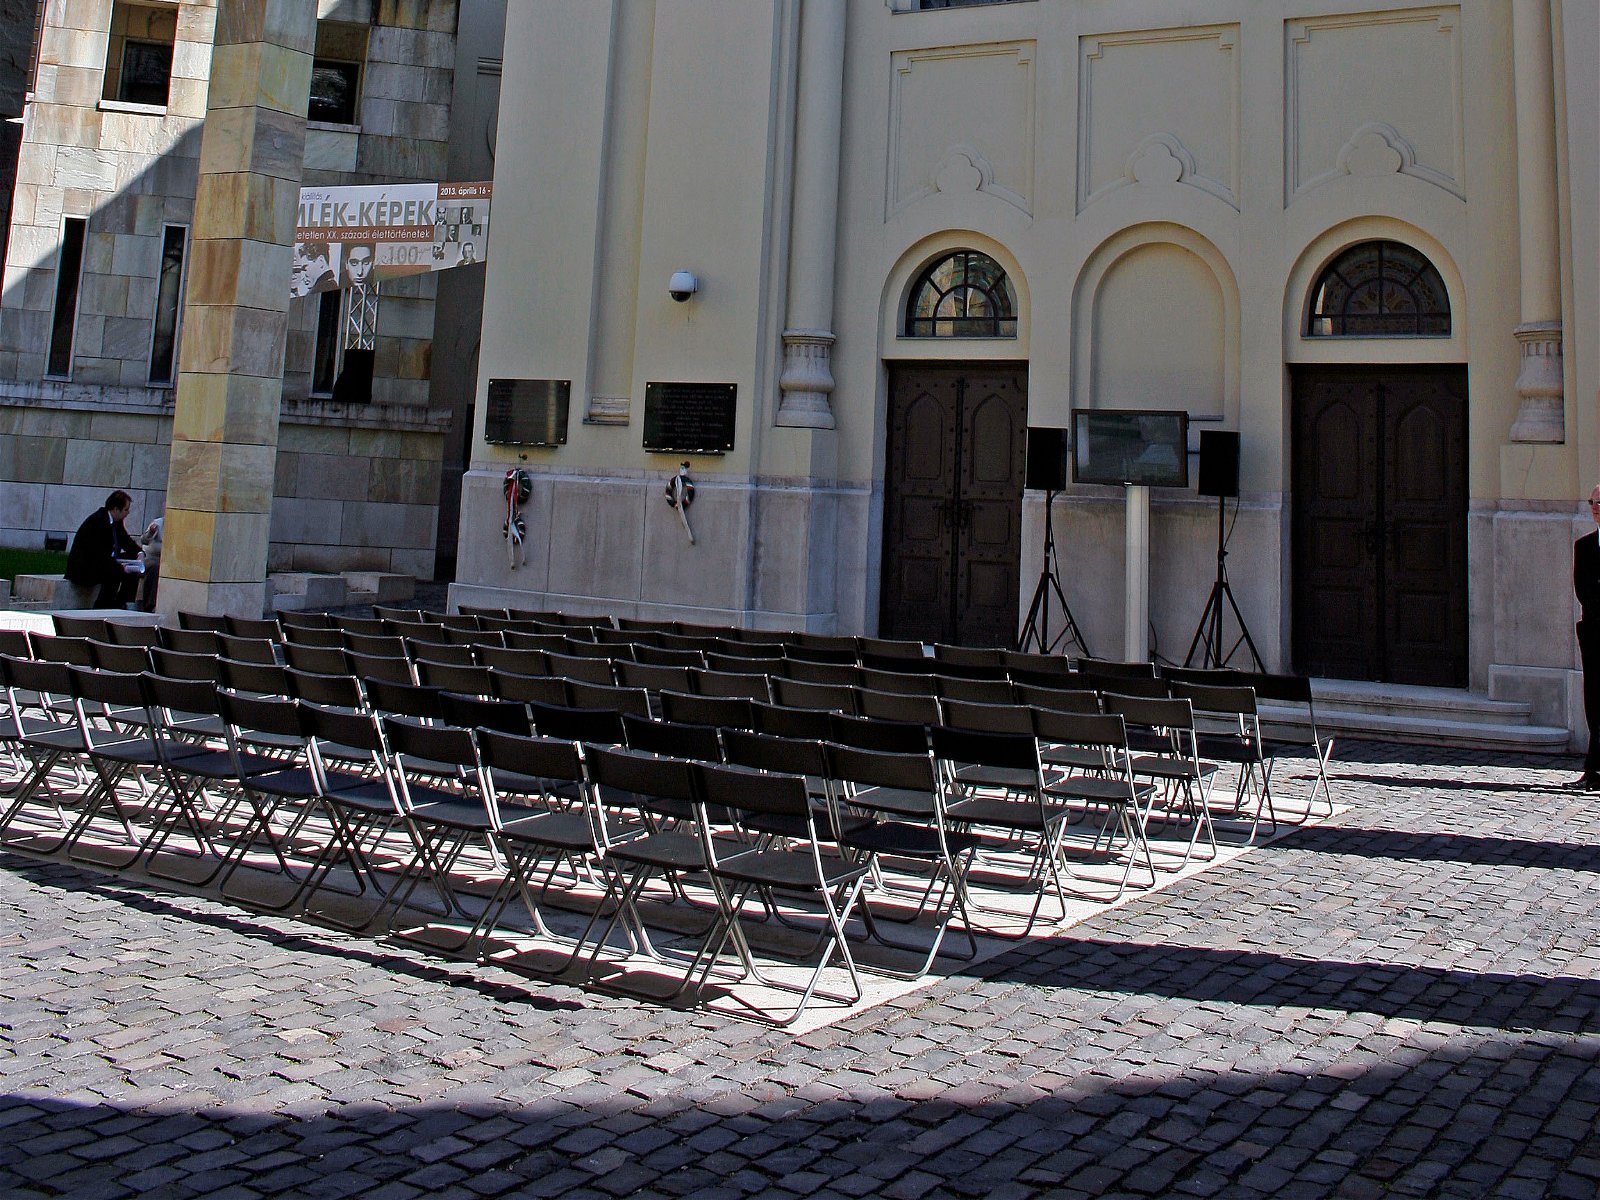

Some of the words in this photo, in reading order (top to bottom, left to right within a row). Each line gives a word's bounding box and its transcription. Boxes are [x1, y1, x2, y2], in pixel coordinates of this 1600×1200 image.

[440, 187, 456, 196] 2013.
[458, 186, 477, 196] április
[479, 186, 487, 195] 16
[327, 231, 339, 240] XX.
[341, 230, 370, 240] századi
[372, 229, 430, 240] élettörténetek
